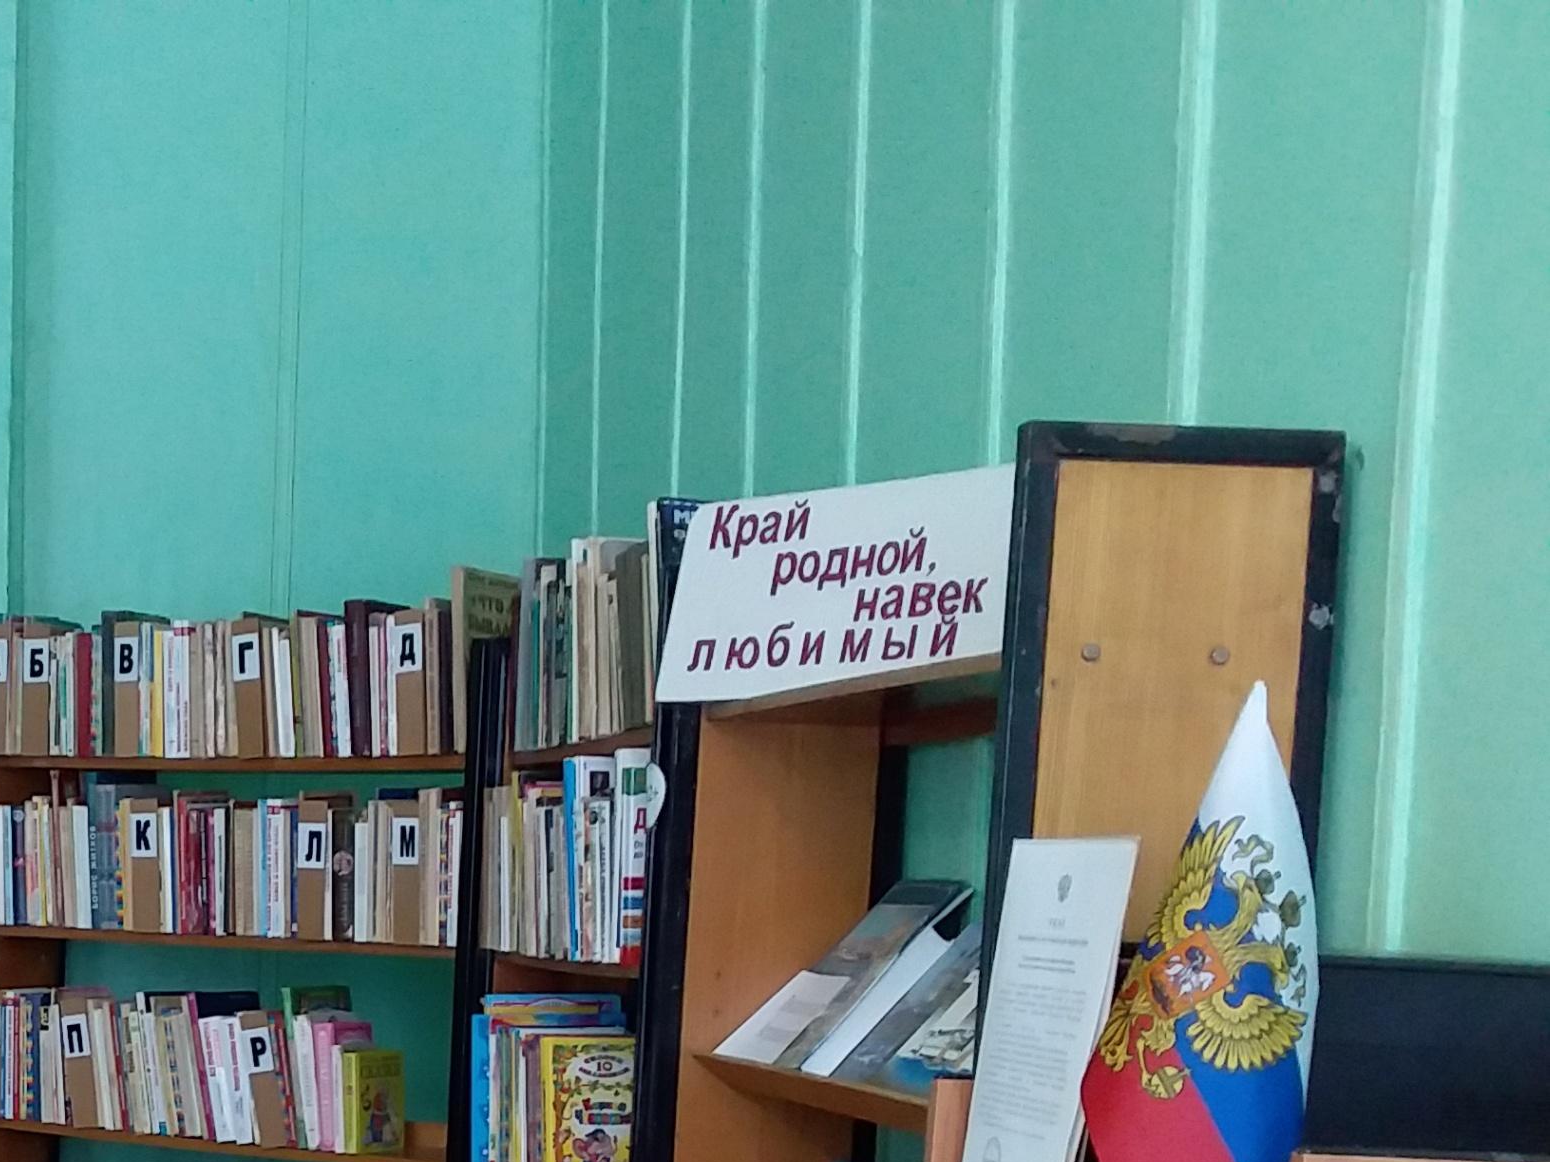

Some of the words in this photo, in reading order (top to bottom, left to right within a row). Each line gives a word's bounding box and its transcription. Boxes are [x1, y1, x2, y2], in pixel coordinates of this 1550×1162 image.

[709, 499, 810, 559] Край
[770, 526, 936, 596] родной,
[853, 577, 988, 622] навек
[119, 644, 133, 674] В
[239, 641, 253, 674] Г
[400, 633, 415, 667] Д
[687, 616, 958, 672] любимый
[30, 648, 43, 677] Б
[136, 820, 150, 850] К
[306, 831, 322, 862] Л
[400, 826, 415, 857] М
[67, 1024, 83, 1053] П
[251, 1037, 266, 1067] Р
[597, 1061, 613, 1072] 10
